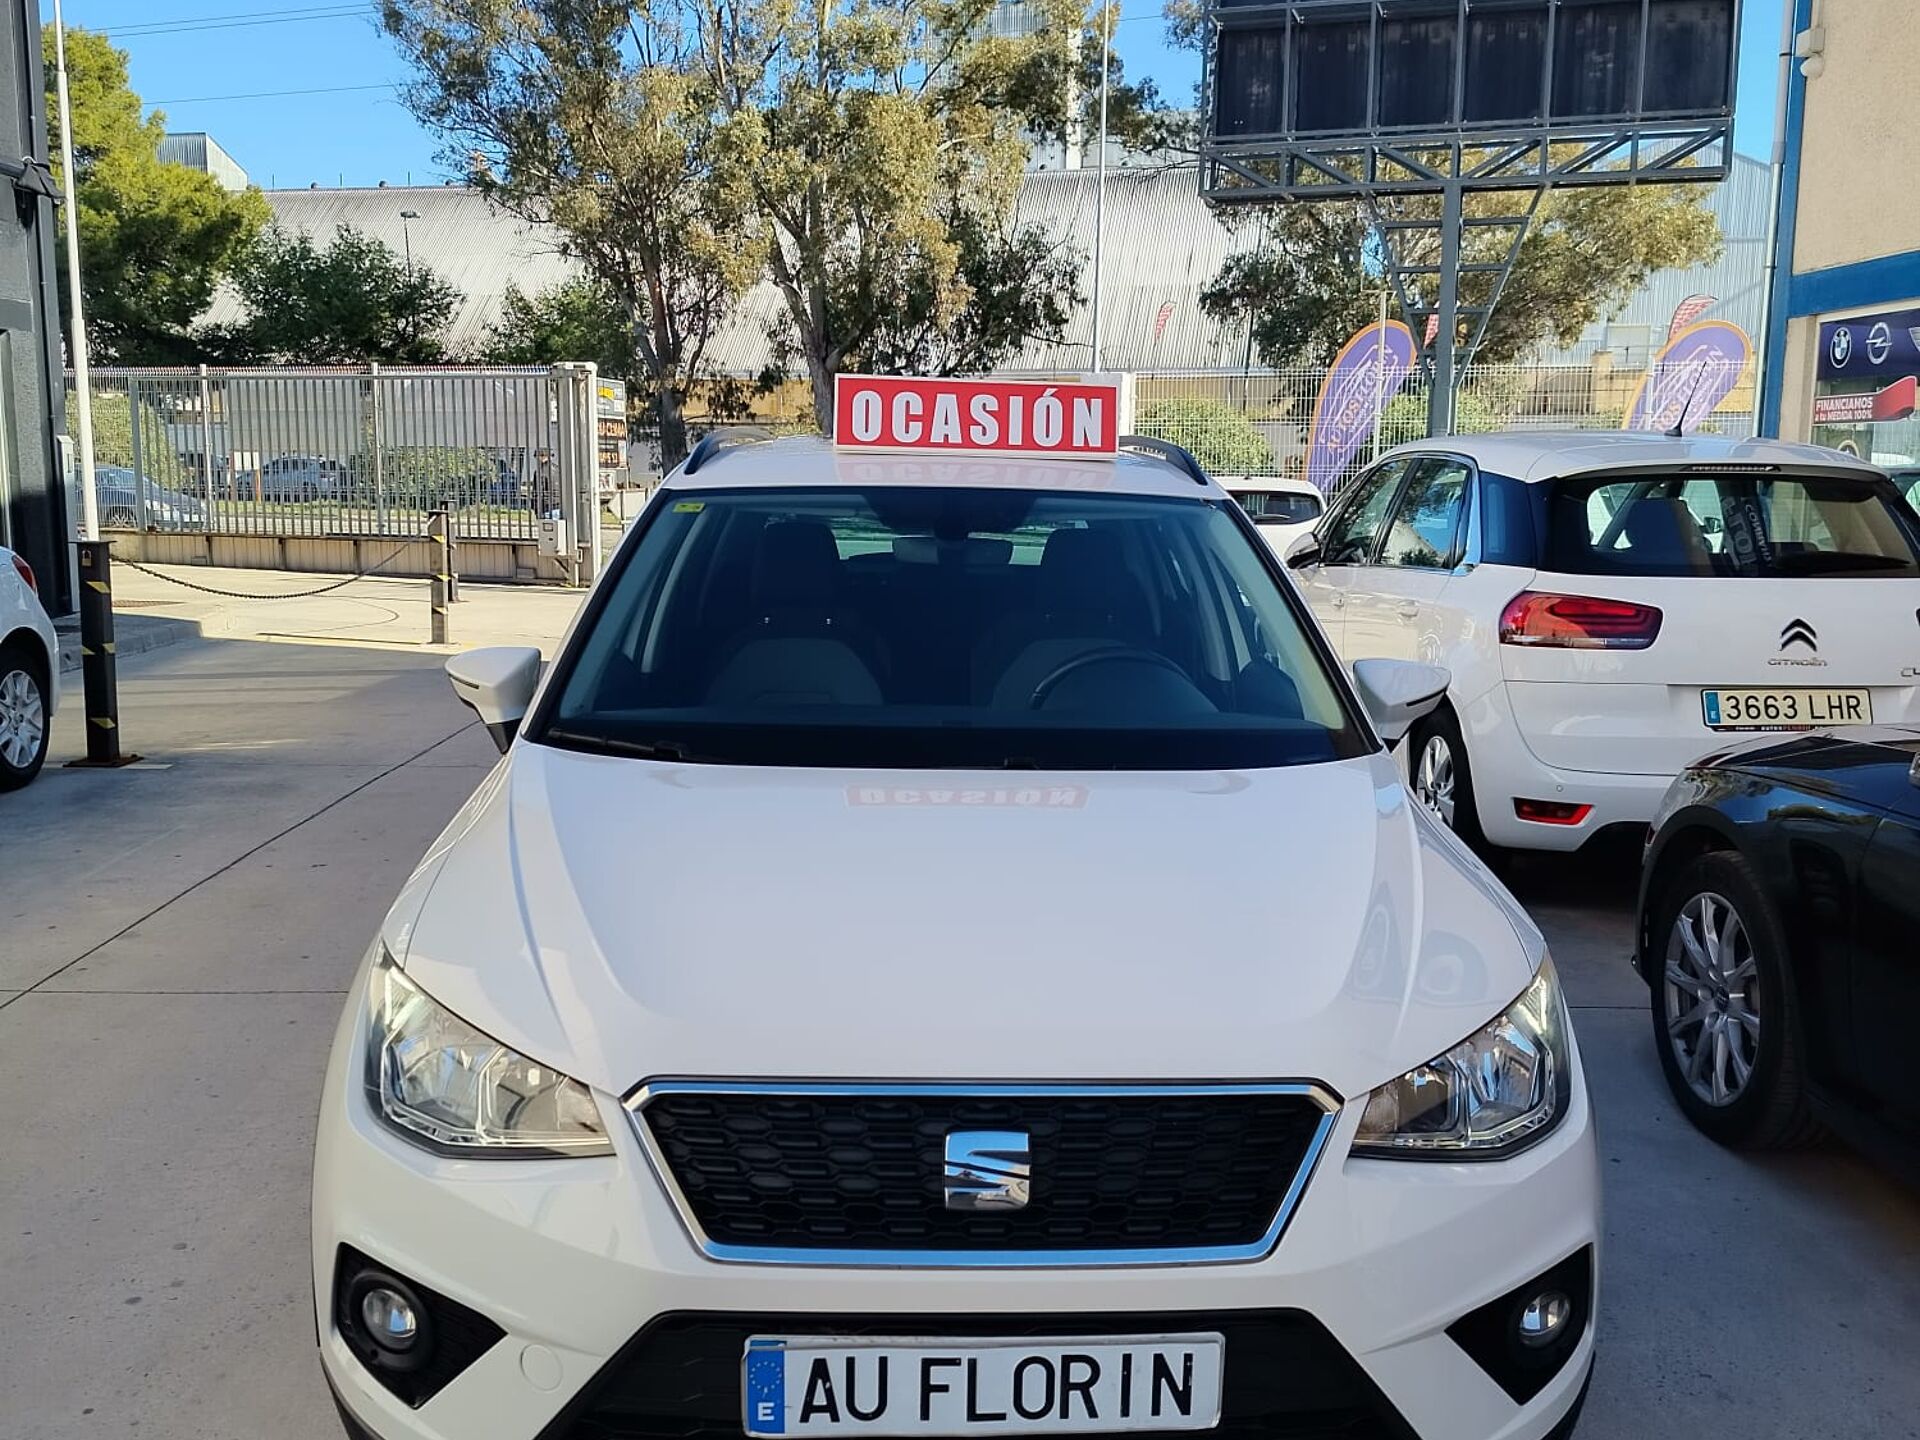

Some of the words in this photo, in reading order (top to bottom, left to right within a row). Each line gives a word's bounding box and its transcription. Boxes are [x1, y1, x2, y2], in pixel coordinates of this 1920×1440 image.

[1815, 396, 1873, 411] FINANCIAMOS
[1828, 410, 1852, 421] MEDIDA
[1855, 408, 1872, 420] 100%
[852, 388, 1102, 447] OCASIÓN
[1725, 695, 1798, 720] 3663
[1808, 695, 1862, 719] LHR
[757, 1403, 774, 1421] E
[799, 1355, 888, 1423] AU
[920, 1352, 1194, 1422] FLORIN
